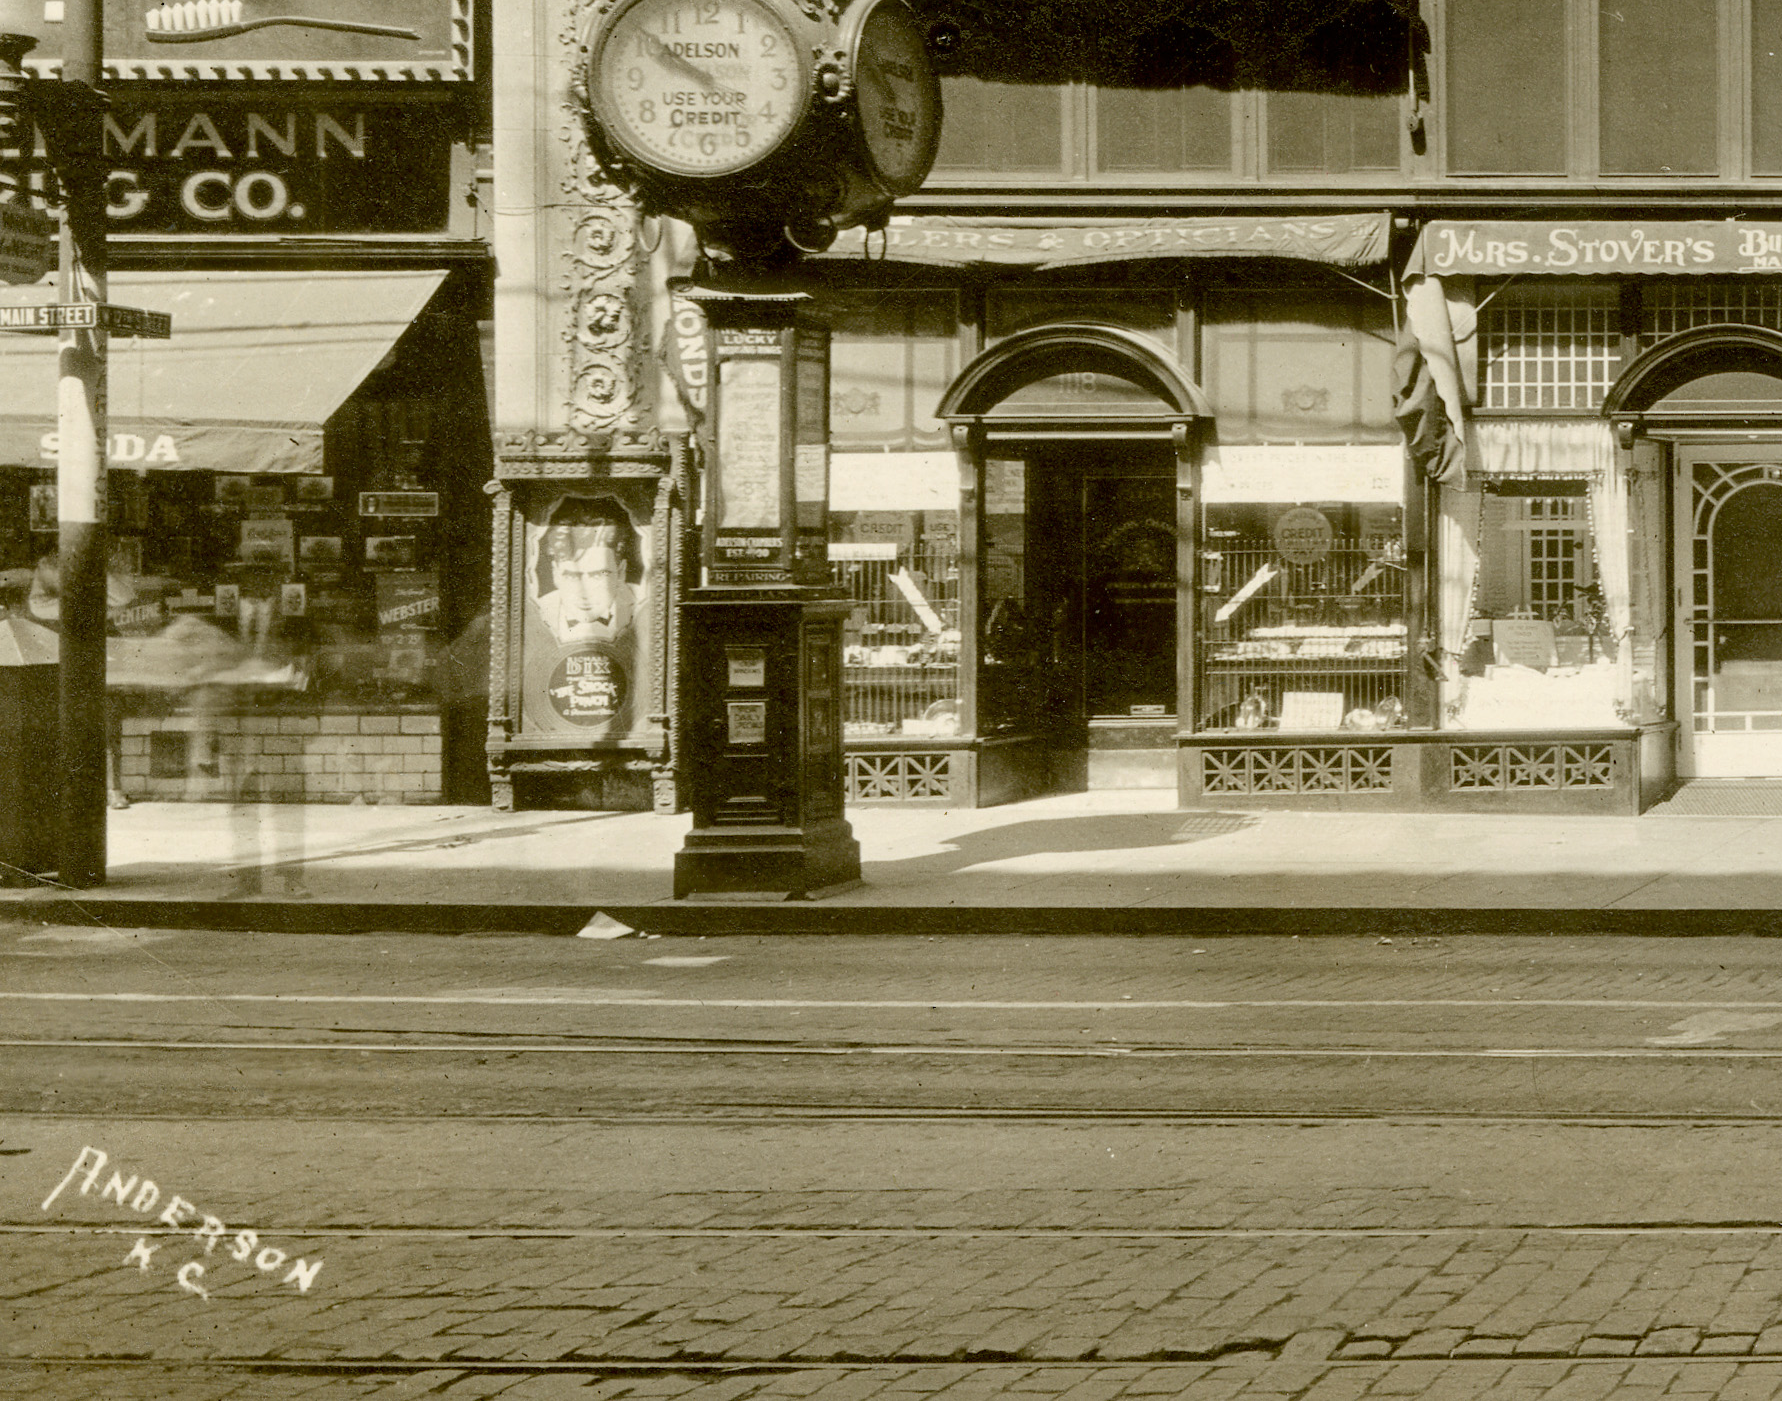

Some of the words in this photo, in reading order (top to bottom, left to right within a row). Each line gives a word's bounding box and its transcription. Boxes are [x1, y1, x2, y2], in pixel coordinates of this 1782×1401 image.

[695, 1, 720, 26] 12
[664, 43, 740, 59] ADELSON
[760, 34, 777, 58] 2
[627, 66, 645, 91] 9
[771, 67, 788, 92] 3
[663, 92, 696, 106] USE
[700, 91, 747, 106] YOUR
[639, 99, 656, 124] 8
[671, 109, 741, 128] CREDIT
[759, 100, 778, 125] 4
[700, 132, 717, 157] 6
[181, 170, 306, 221] CO.
[1037, 232, 1065, 249] &
[1083, 222, 1337, 248] OPTICIANS
[0, 306, 35, 326] MAIN
[39, 305, 92, 326] STREET
[724, 335, 777, 345] LUCKY
[40, 432, 181, 462] SDA
[1281, 528, 1325, 540] CREDIT
[378, 597, 440, 625] WEBSTER
[566, 662, 611, 675] DIX
